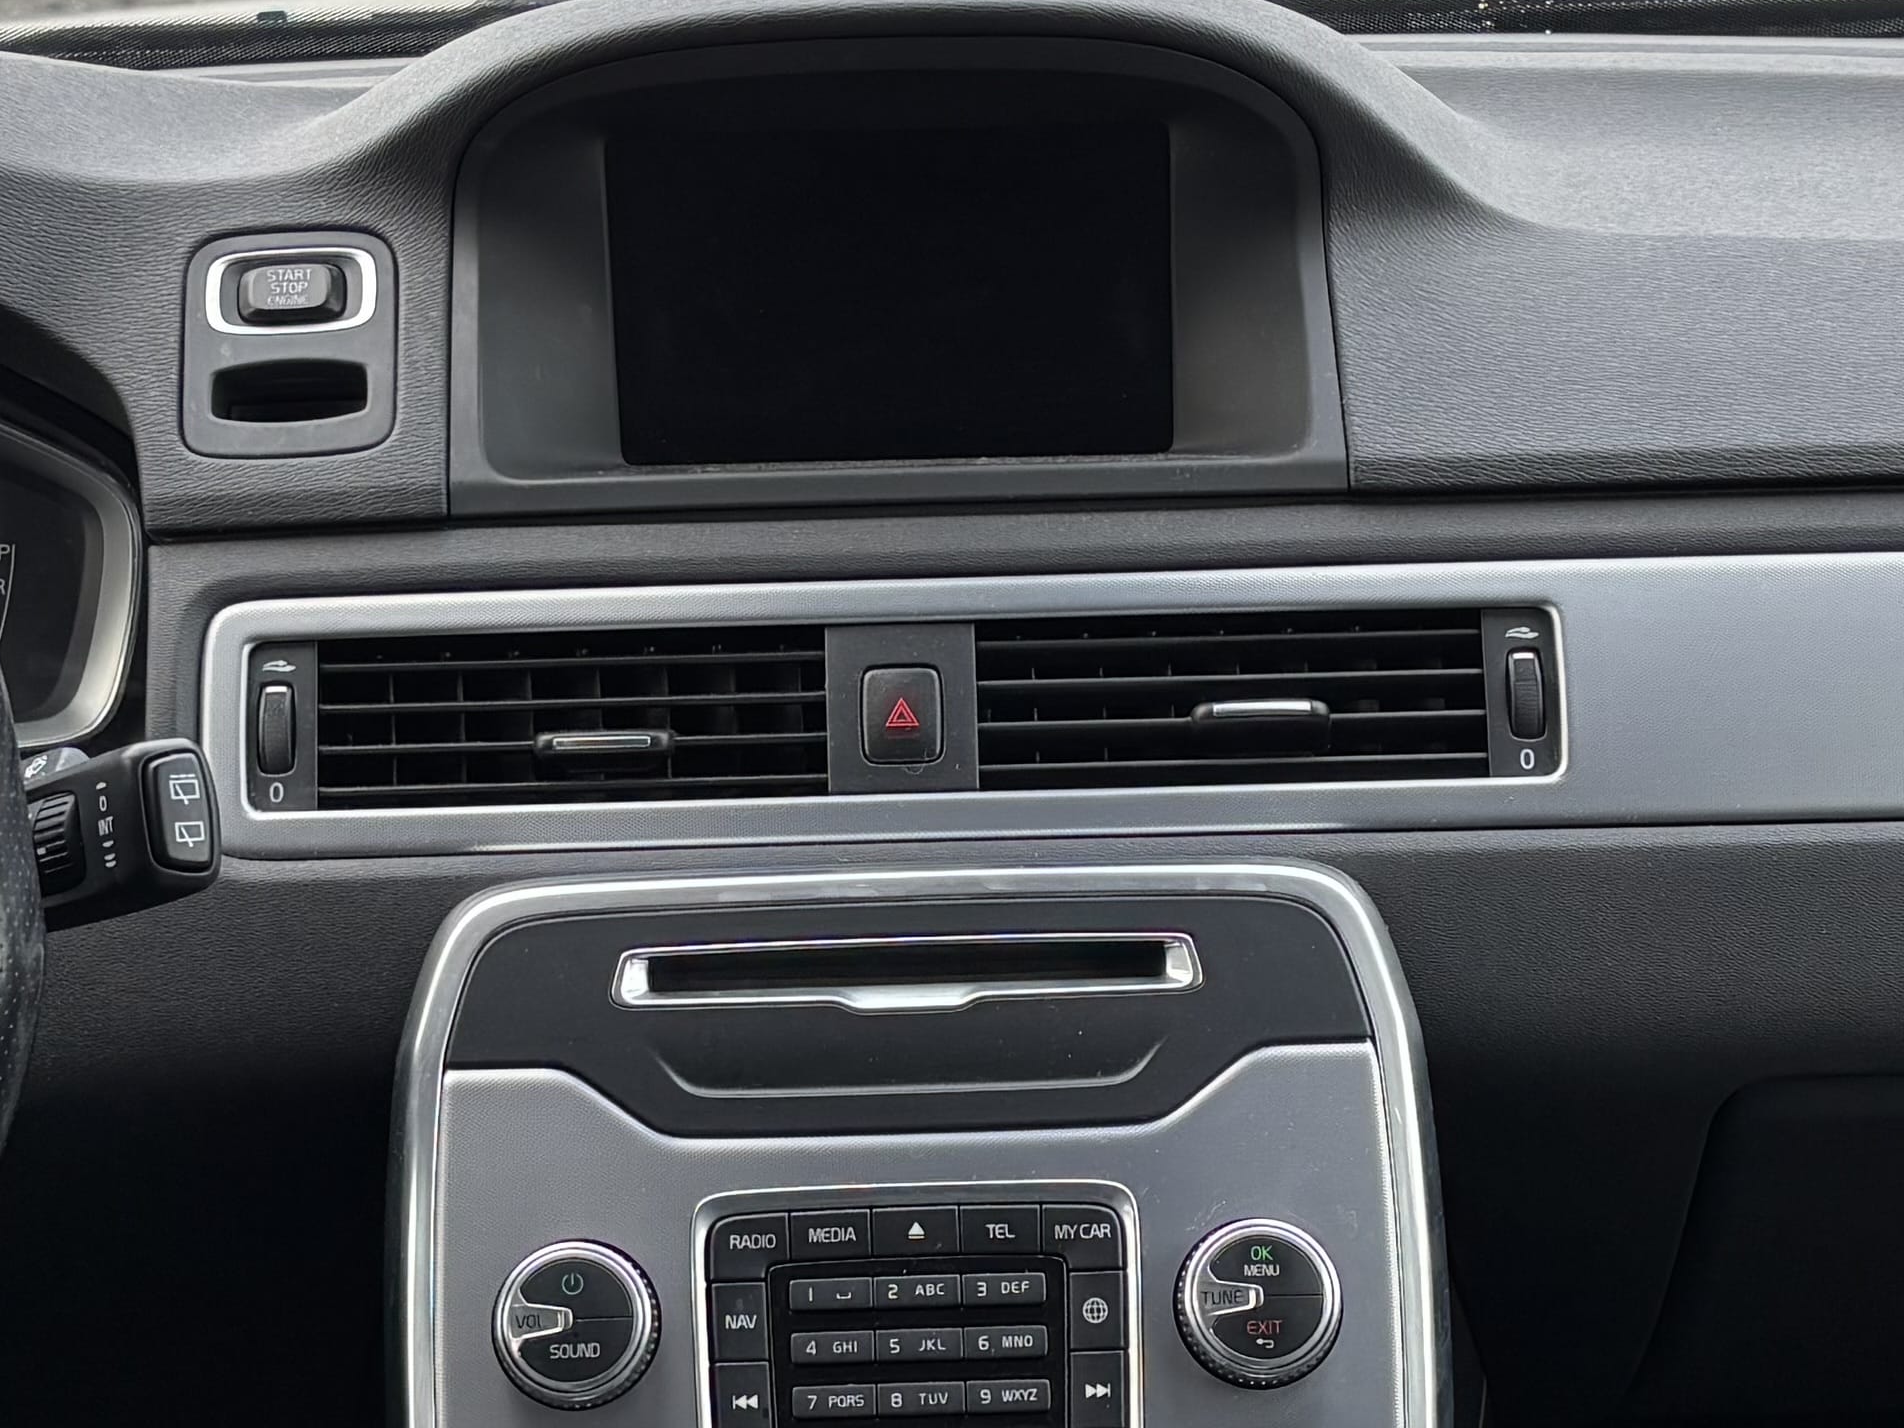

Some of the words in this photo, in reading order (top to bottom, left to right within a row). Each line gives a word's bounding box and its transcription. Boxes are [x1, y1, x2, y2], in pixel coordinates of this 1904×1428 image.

[267, 268, 312, 282] START
[270, 281, 308, 294] STOP
[98, 816, 114, 836] INT
[808, 1227, 857, 1244] MEDIA
[985, 1223, 1016, 1240] TEL
[1055, 1224, 1078, 1239] MY
[1080, 1223, 1112, 1239] CAR
[729, 1234, 777, 1250] RADIO
[1250, 1245, 1274, 1261] OK
[1243, 1264, 1280, 1277] MENU
[887, 1284, 899, 1300] 2
[915, 1283, 945, 1296] ABC
[977, 1281, 988, 1297] 3
[1001, 1280, 1030, 1294] DEF
[1201, 1289, 1244, 1305] TUNE
[725, 1314, 757, 1330] NAV
[1246, 1320, 1283, 1335] EXIT
[549, 1342, 601, 1359] SOUND
[805, 1340, 817, 1356] 4
[832, 1340, 858, 1355] GHI
[889, 1339, 900, 1355] 5
[919, 1338, 946, 1352] JKL
[978, 1335, 990, 1351] 6
[1001, 1335, 1033, 1348] MNO
[807, 1395, 818, 1411] 7
[828, 1393, 865, 1409] PQRS
[891, 1392, 903, 1408] 8
[919, 1392, 949, 1406] TUV
[980, 1389, 992, 1404] 9
[1001, 1388, 1038, 1403] WXYZ
